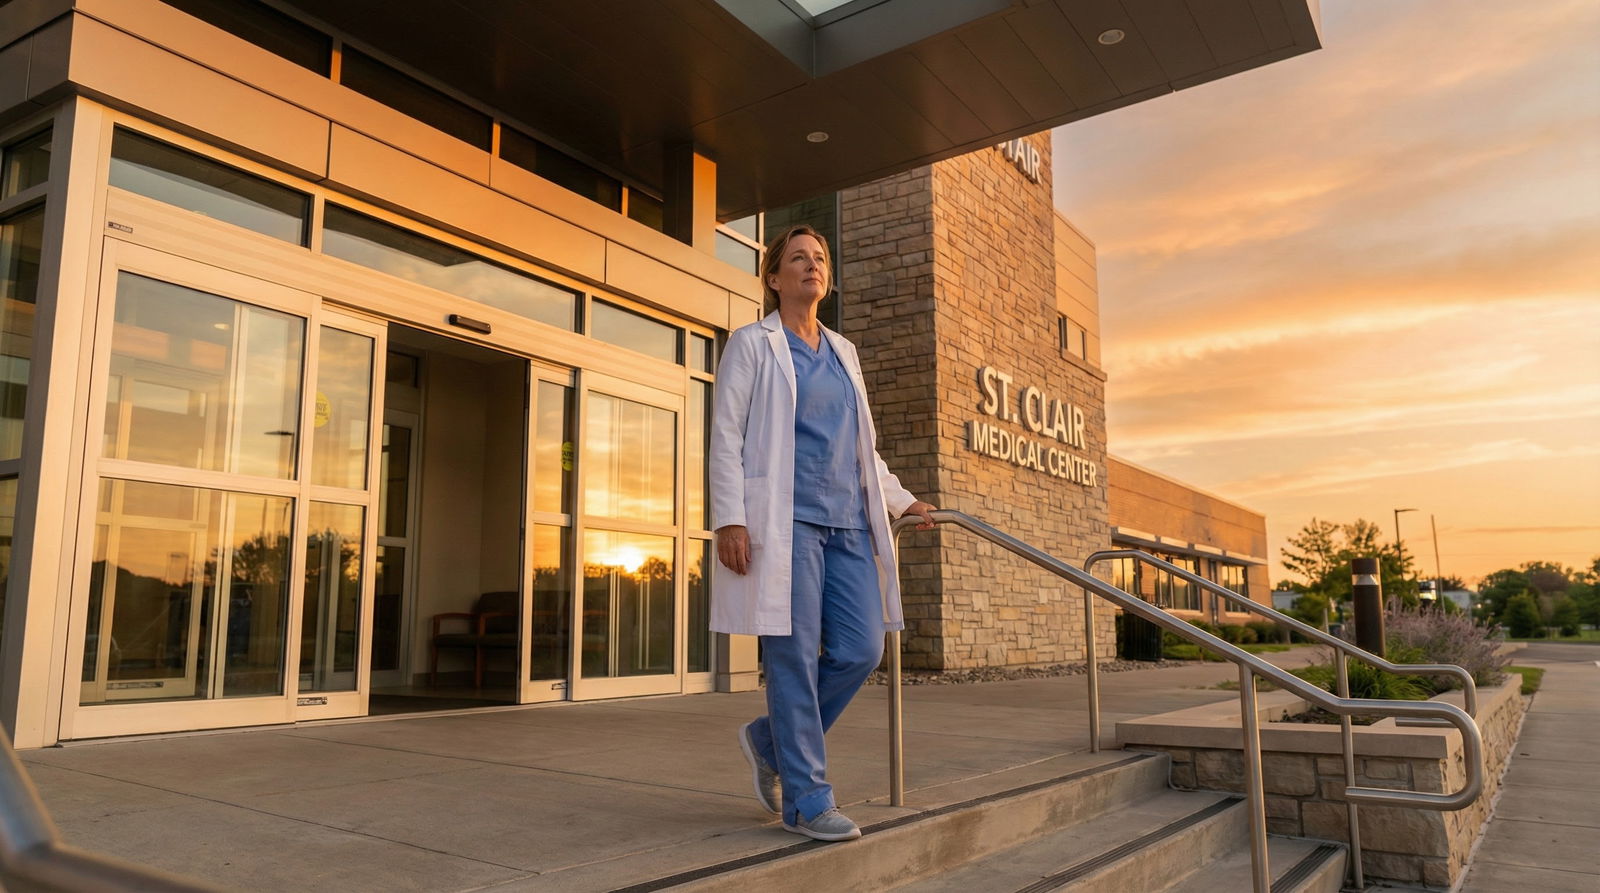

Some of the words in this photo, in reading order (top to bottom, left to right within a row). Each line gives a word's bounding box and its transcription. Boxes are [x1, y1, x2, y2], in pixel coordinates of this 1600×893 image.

[980, 366, 1018, 424] ST.
[1024, 386, 1086, 449] CLAIR
[972, 420, 1045, 472] MEDICAL
[1048, 447, 1097, 487] CENTER
